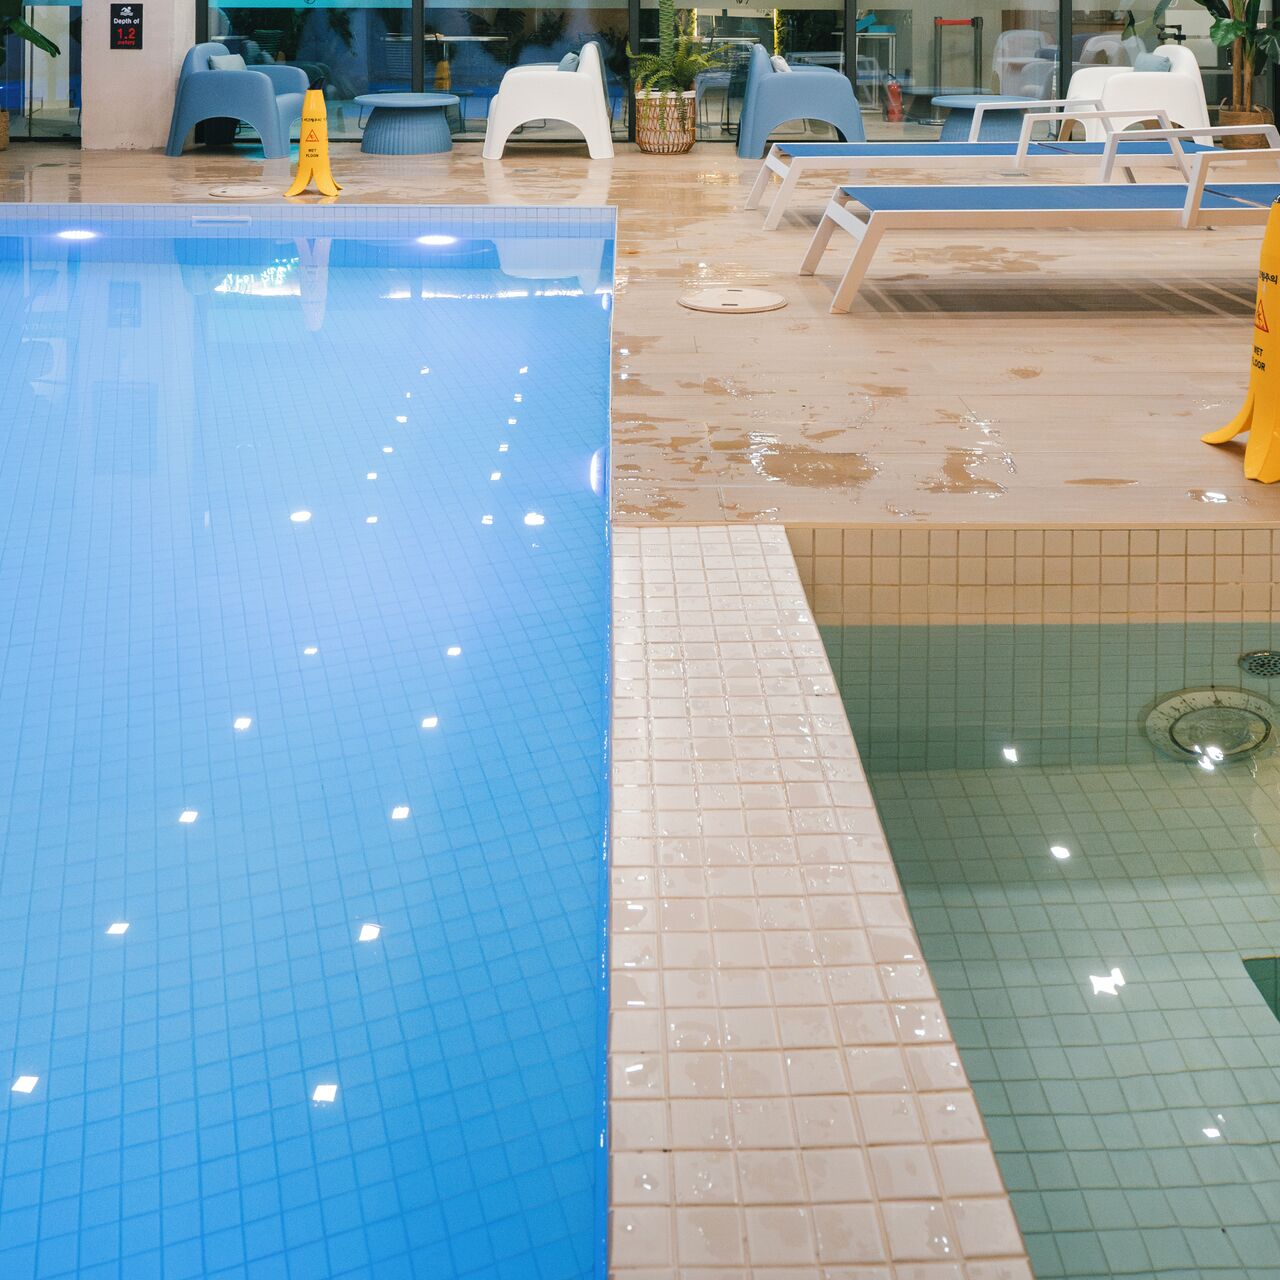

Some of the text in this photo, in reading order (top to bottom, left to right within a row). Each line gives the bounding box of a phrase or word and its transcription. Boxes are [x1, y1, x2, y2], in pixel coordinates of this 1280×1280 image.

[113, 17, 140, 25] Depth of
[117, 27, 136, 39] 1.2
